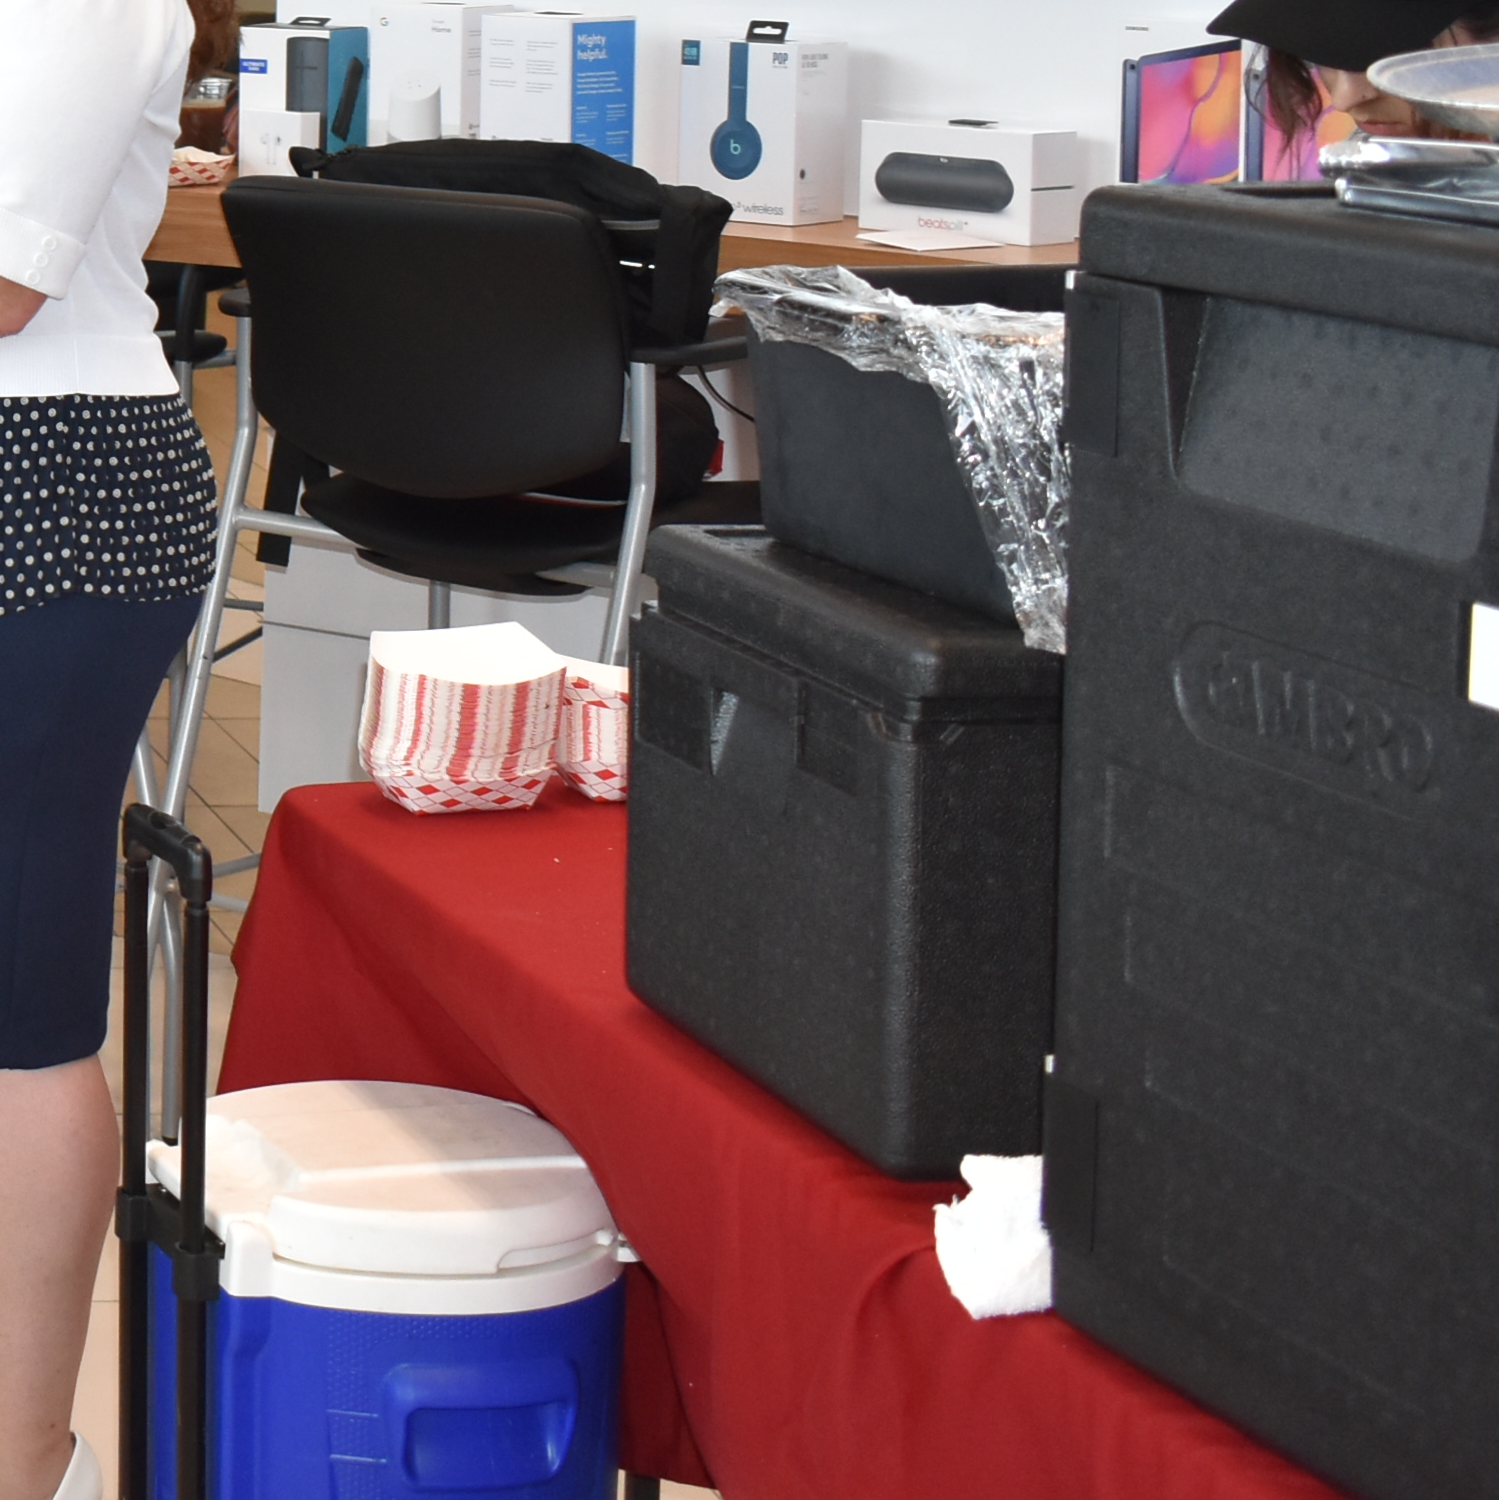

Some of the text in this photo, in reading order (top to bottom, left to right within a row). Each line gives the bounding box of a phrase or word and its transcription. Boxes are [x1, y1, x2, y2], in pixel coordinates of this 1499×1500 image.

[577, 33, 607, 48] Mighty
[772, 51, 789, 64] POP
[744, 203, 784, 216] wireless
